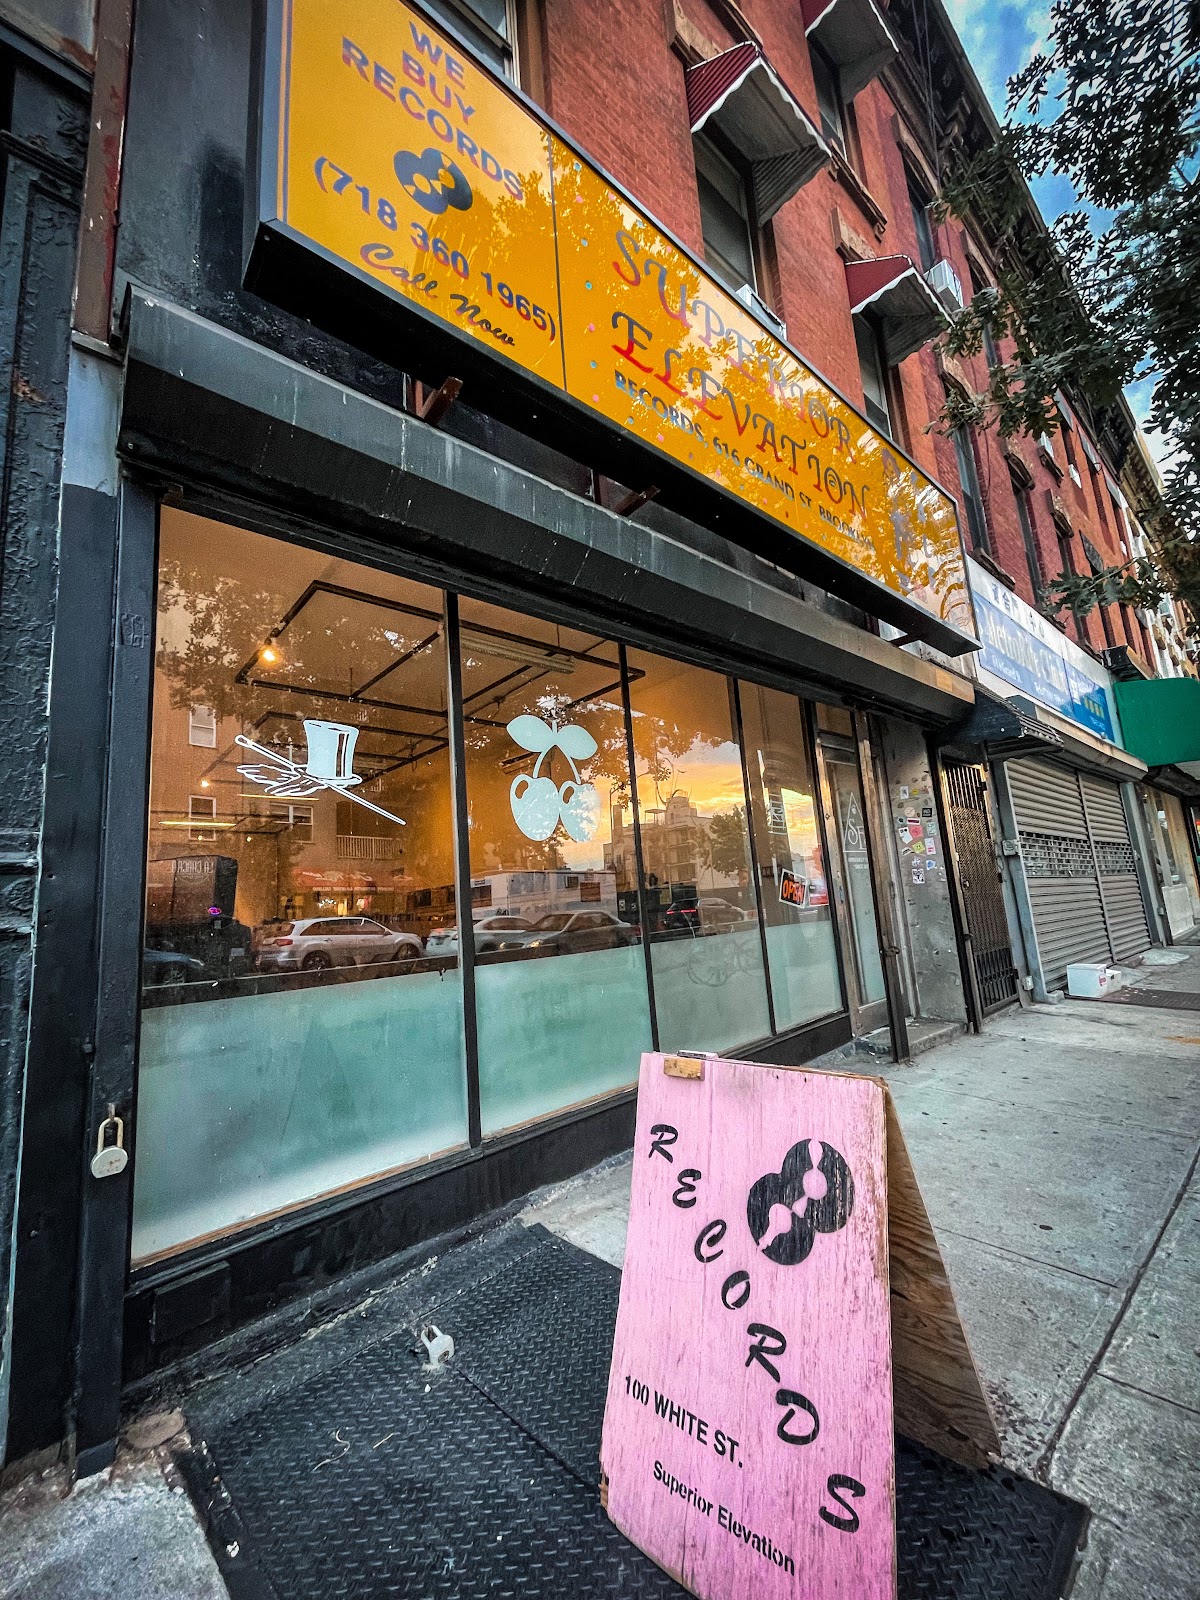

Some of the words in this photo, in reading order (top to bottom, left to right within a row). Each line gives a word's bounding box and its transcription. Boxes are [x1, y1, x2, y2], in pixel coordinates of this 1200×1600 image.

[402, 50, 475, 126] BUY
[409, 21, 465, 90] WE
[341, 35, 524, 201] RECORDS
[313, 156, 398, 232] (718
[410, 221, 470, 281] 360
[481, 271, 556, 342] 1965)
[360, 243, 439, 299] Call
[612, 230, 857, 464] SUPERIOR
[611, 311, 870, 521] ELEVATION
[744, 456, 795, 501] GRAND
[799, 491, 812, 510] ST
[782, 879, 805, 904] OPEN
[647, 1124, 866, 1534] RECORDS
[624, 1374, 650, 1407] 100
[654, 1396, 709, 1447] WHITE
[712, 1426, 744, 1468] ST.
[652, 1460, 713, 1519] Superior
[716, 1510, 796, 1577] Elevation
